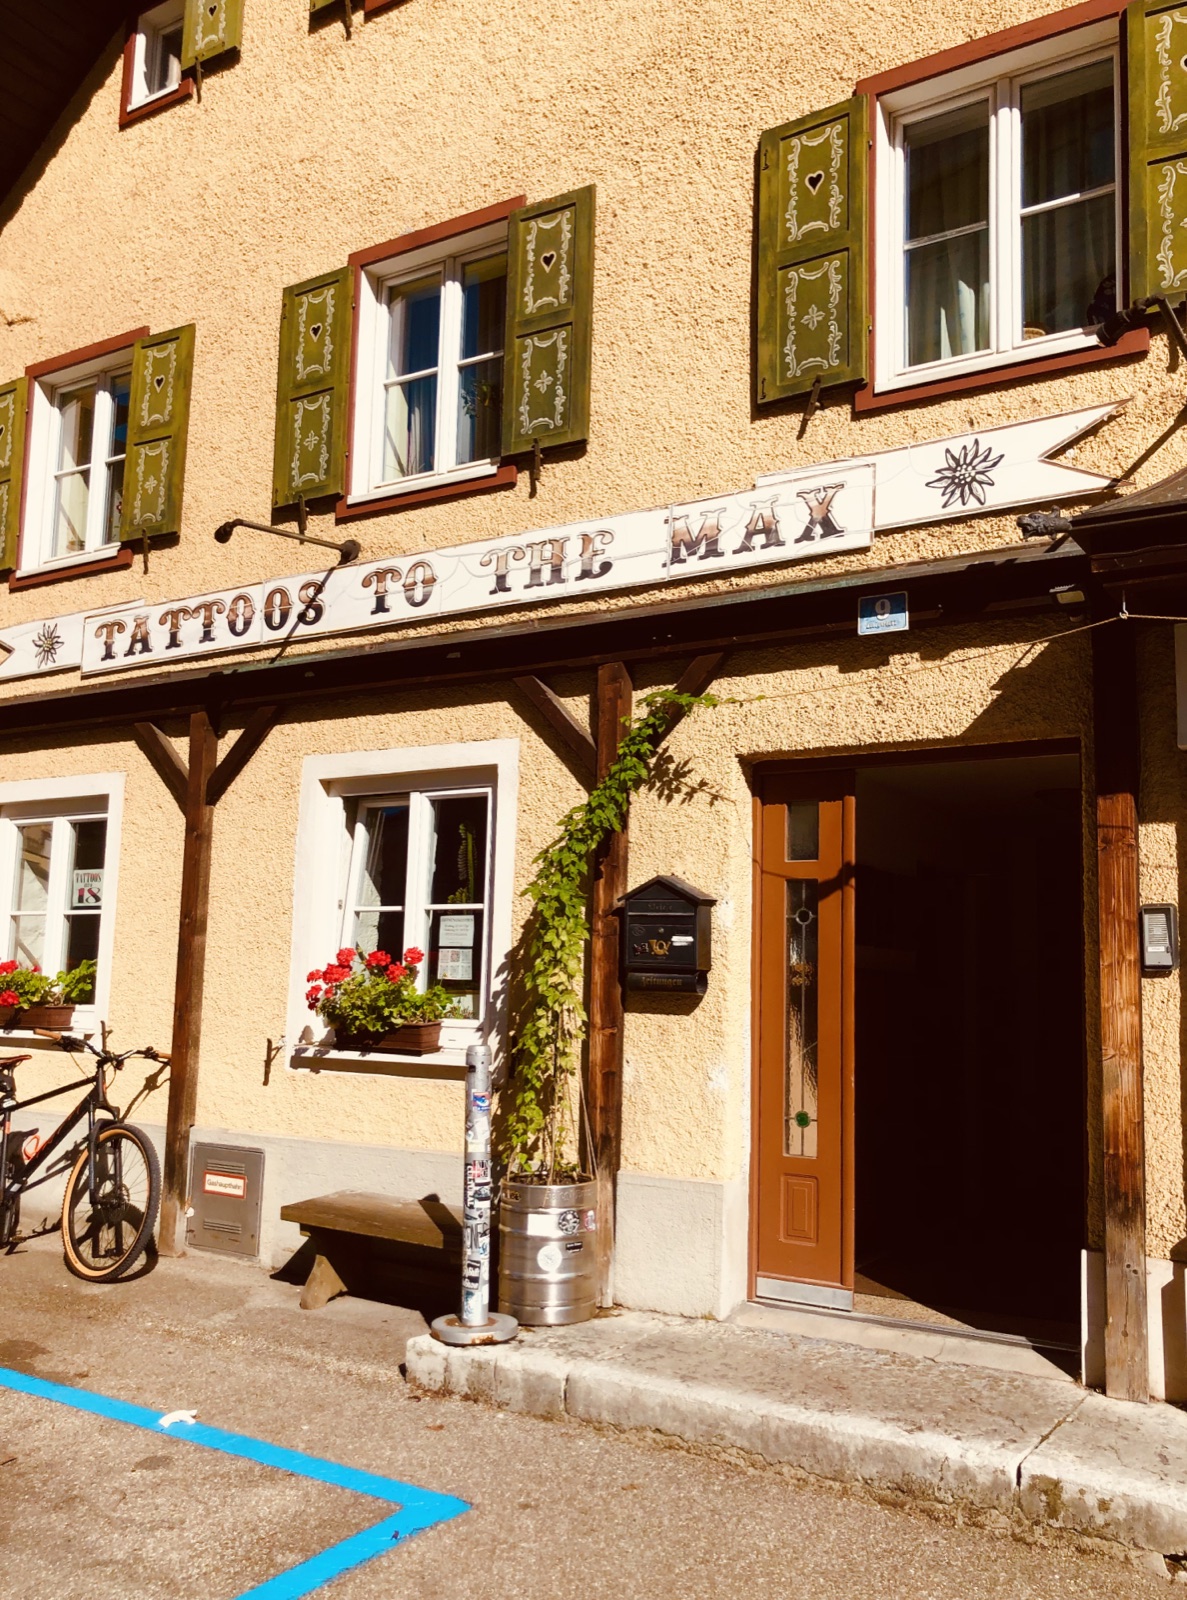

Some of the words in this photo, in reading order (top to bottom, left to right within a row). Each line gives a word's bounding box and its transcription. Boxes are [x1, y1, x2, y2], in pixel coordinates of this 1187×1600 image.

[95, 578, 326, 662] TATTOOS
[361, 560, 439, 616] TO
[479, 529, 616, 596] THE
[661, 481, 848, 569] MAX
[875, 598, 891, 621] 9
[77, 887, 102, 904] 18
